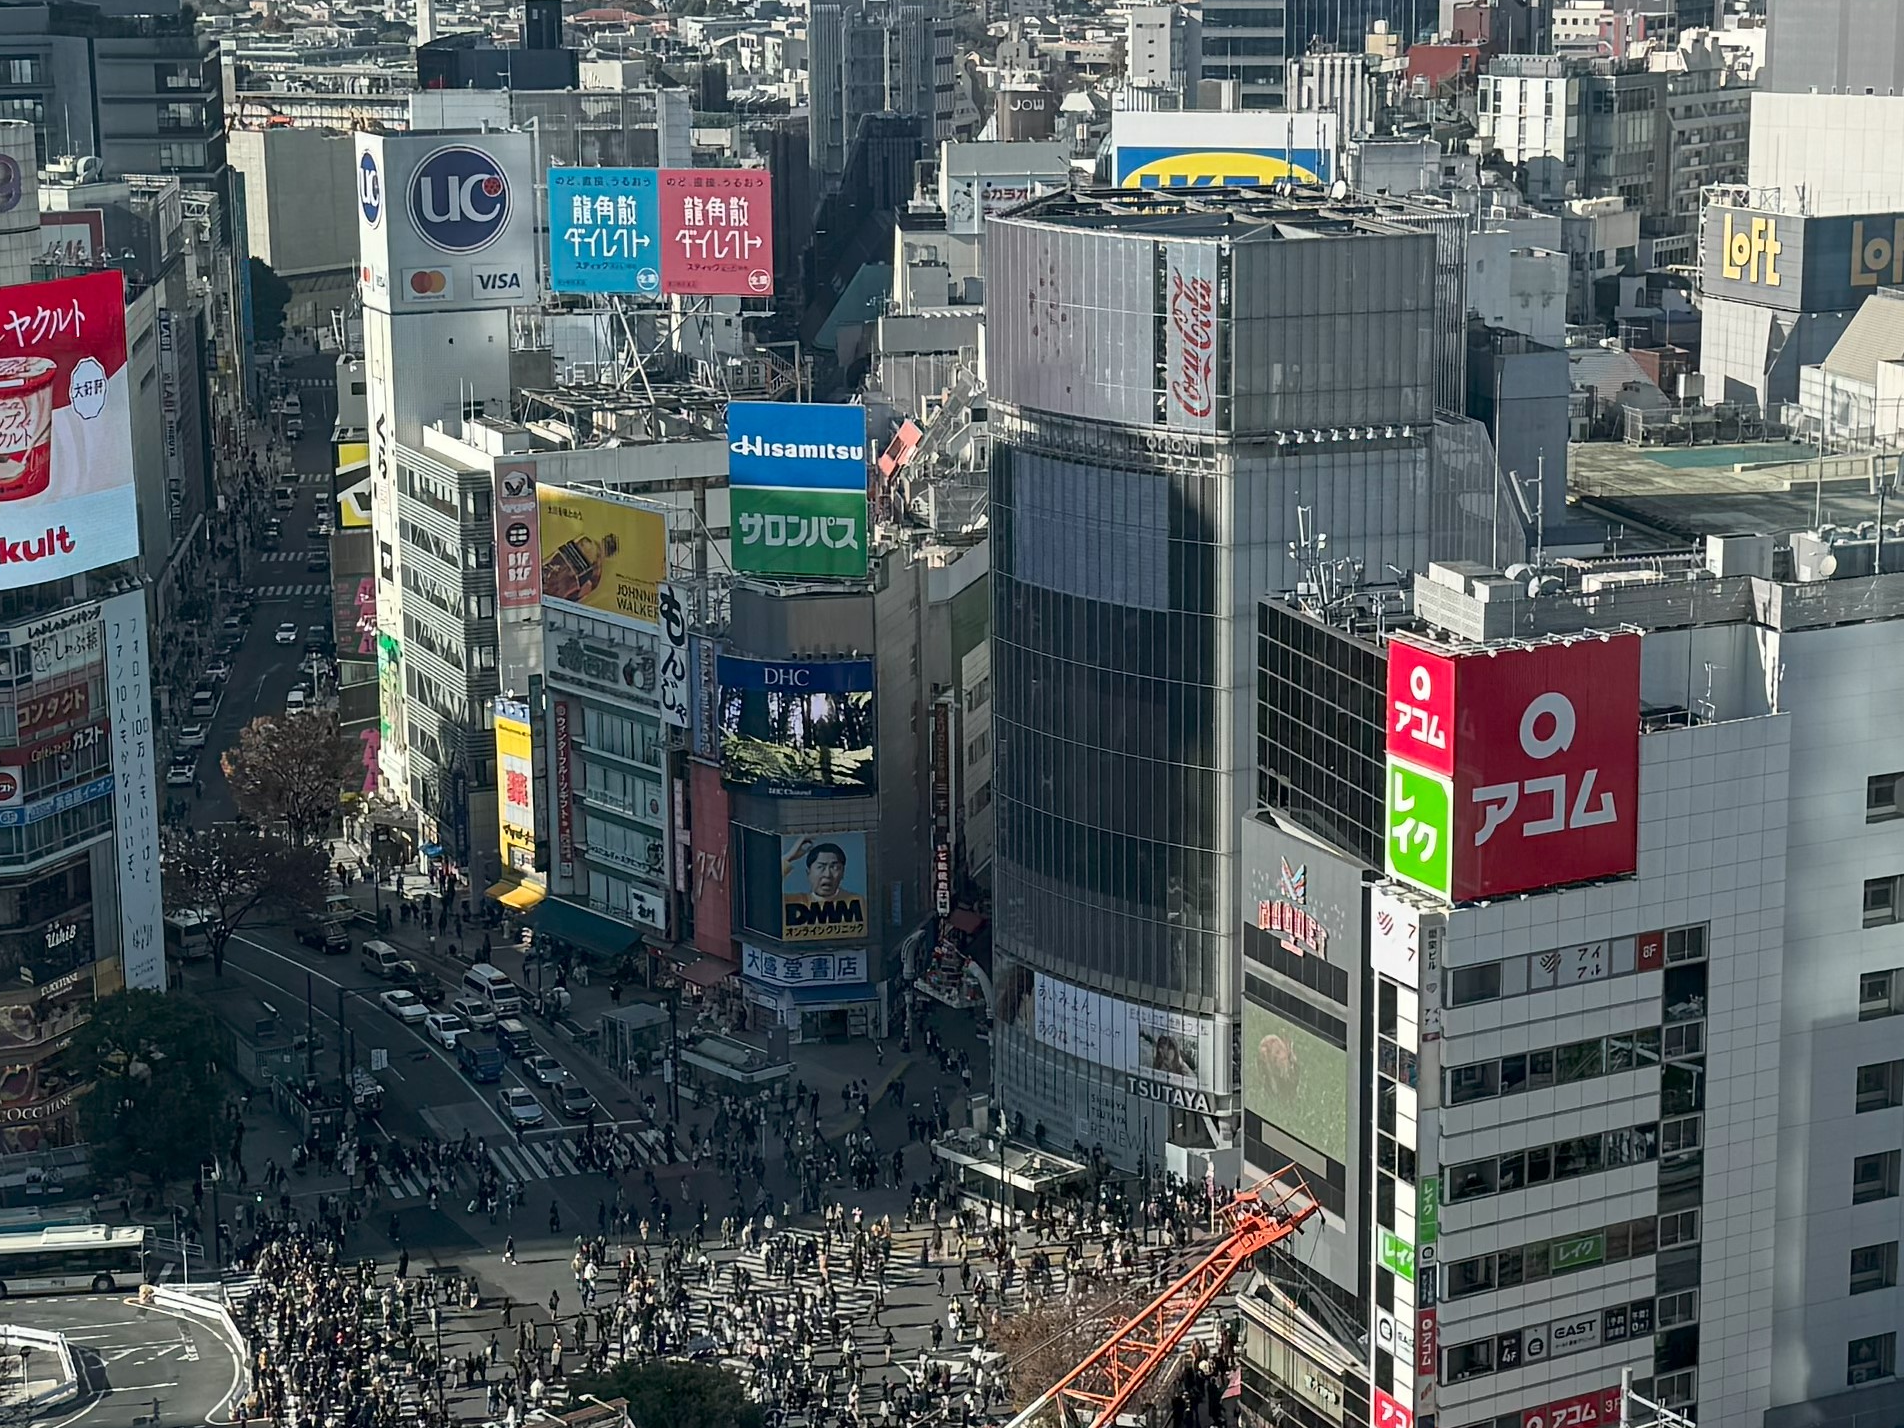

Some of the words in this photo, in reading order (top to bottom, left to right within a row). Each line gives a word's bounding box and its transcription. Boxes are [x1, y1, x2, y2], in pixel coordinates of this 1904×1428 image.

[572, 195, 637, 225] 龍角散
[683, 196, 749, 227] 龍角散
[564, 228, 651, 258] ダイレクト
[675, 229, 763, 260] ダイレクト
[476, 272, 520, 291] VISA
[730, 435, 863, 460] Hisamitsu
[739, 513, 858, 549] サロンパス
[659, 584, 688, 724] もんじゃ
[764, 668, 809, 686] DHC
[1394, 701, 1446, 749] アコム
[1472, 768, 1618, 847] アコム
[786, 899, 863, 925] DMM
[785, 924, 864, 937] オンラインクリニック
[748, 950, 857, 979] 大盛堂書店
[1127, 1076, 1210, 1112] TSUTAYA
[1559, 1240, 1594, 1261] レイク
[1554, 1319, 1597, 1339] EAST
[1502, 1347, 1517, 1362] 4F
